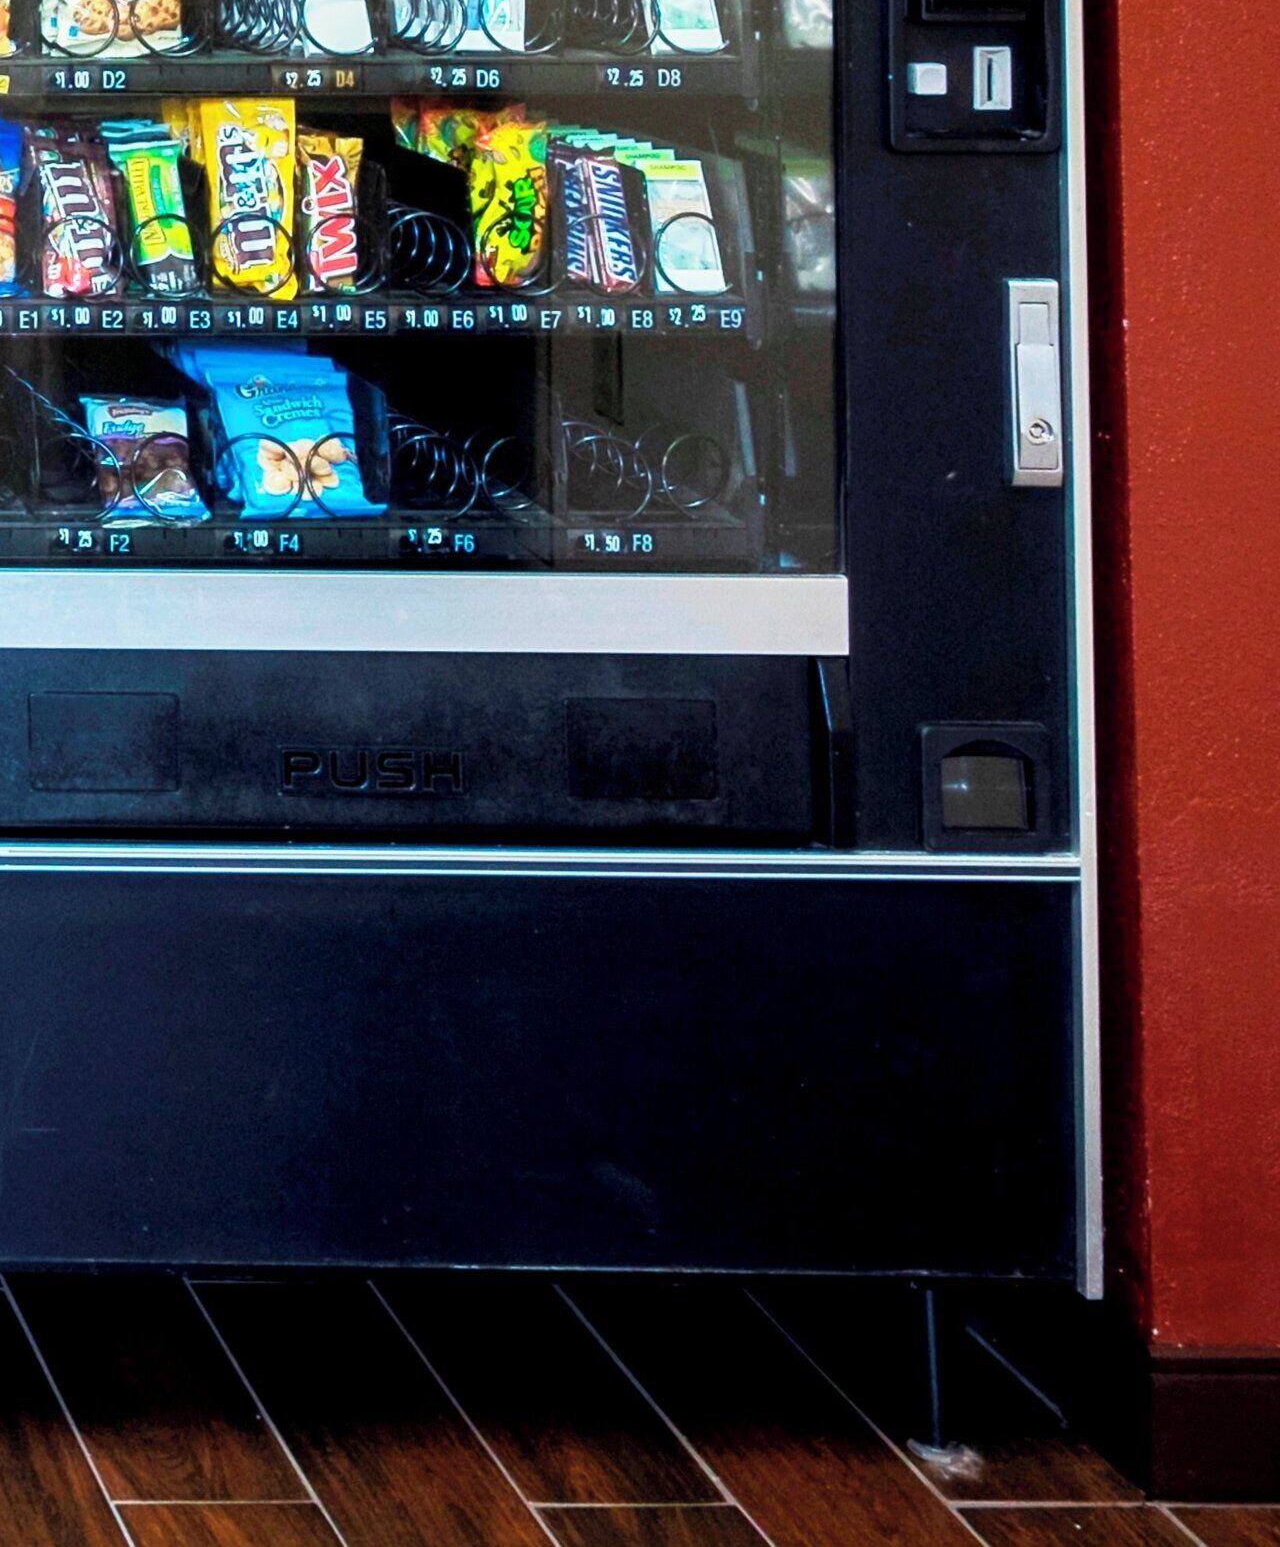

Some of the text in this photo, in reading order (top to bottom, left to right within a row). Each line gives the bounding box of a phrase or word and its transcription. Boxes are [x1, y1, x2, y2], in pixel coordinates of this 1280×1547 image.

[55, 70, 126, 89] $1.00 D2
[335, 70, 355, 87] D4
[476, 69, 500, 88] D6
[657, 68, 681, 87] D8
[592, 164, 638, 284] SNICKERS
[19, 310, 39, 329] E1
[51, 306, 124, 329] $1.00 E2
[189, 310, 211, 329] E3
[228, 306, 298, 329] $1.00 E4
[313, 304, 387, 329] $1.00 E5
[406, 309, 474, 329] $1.00 E6
[489, 304, 561, 329] $1.00 E7
[632, 310, 654, 329] E8
[669, 304, 742, 329] $2.25 E9
[254, 395, 324, 417] Sandwich
[261, 407, 321, 429] Cremes
[109, 534, 130, 552] F2
[279, 533, 299, 552] F4
[454, 534, 475, 553] F6
[632, 534, 653, 552] F8
[280, 749, 467, 793] PUSH
